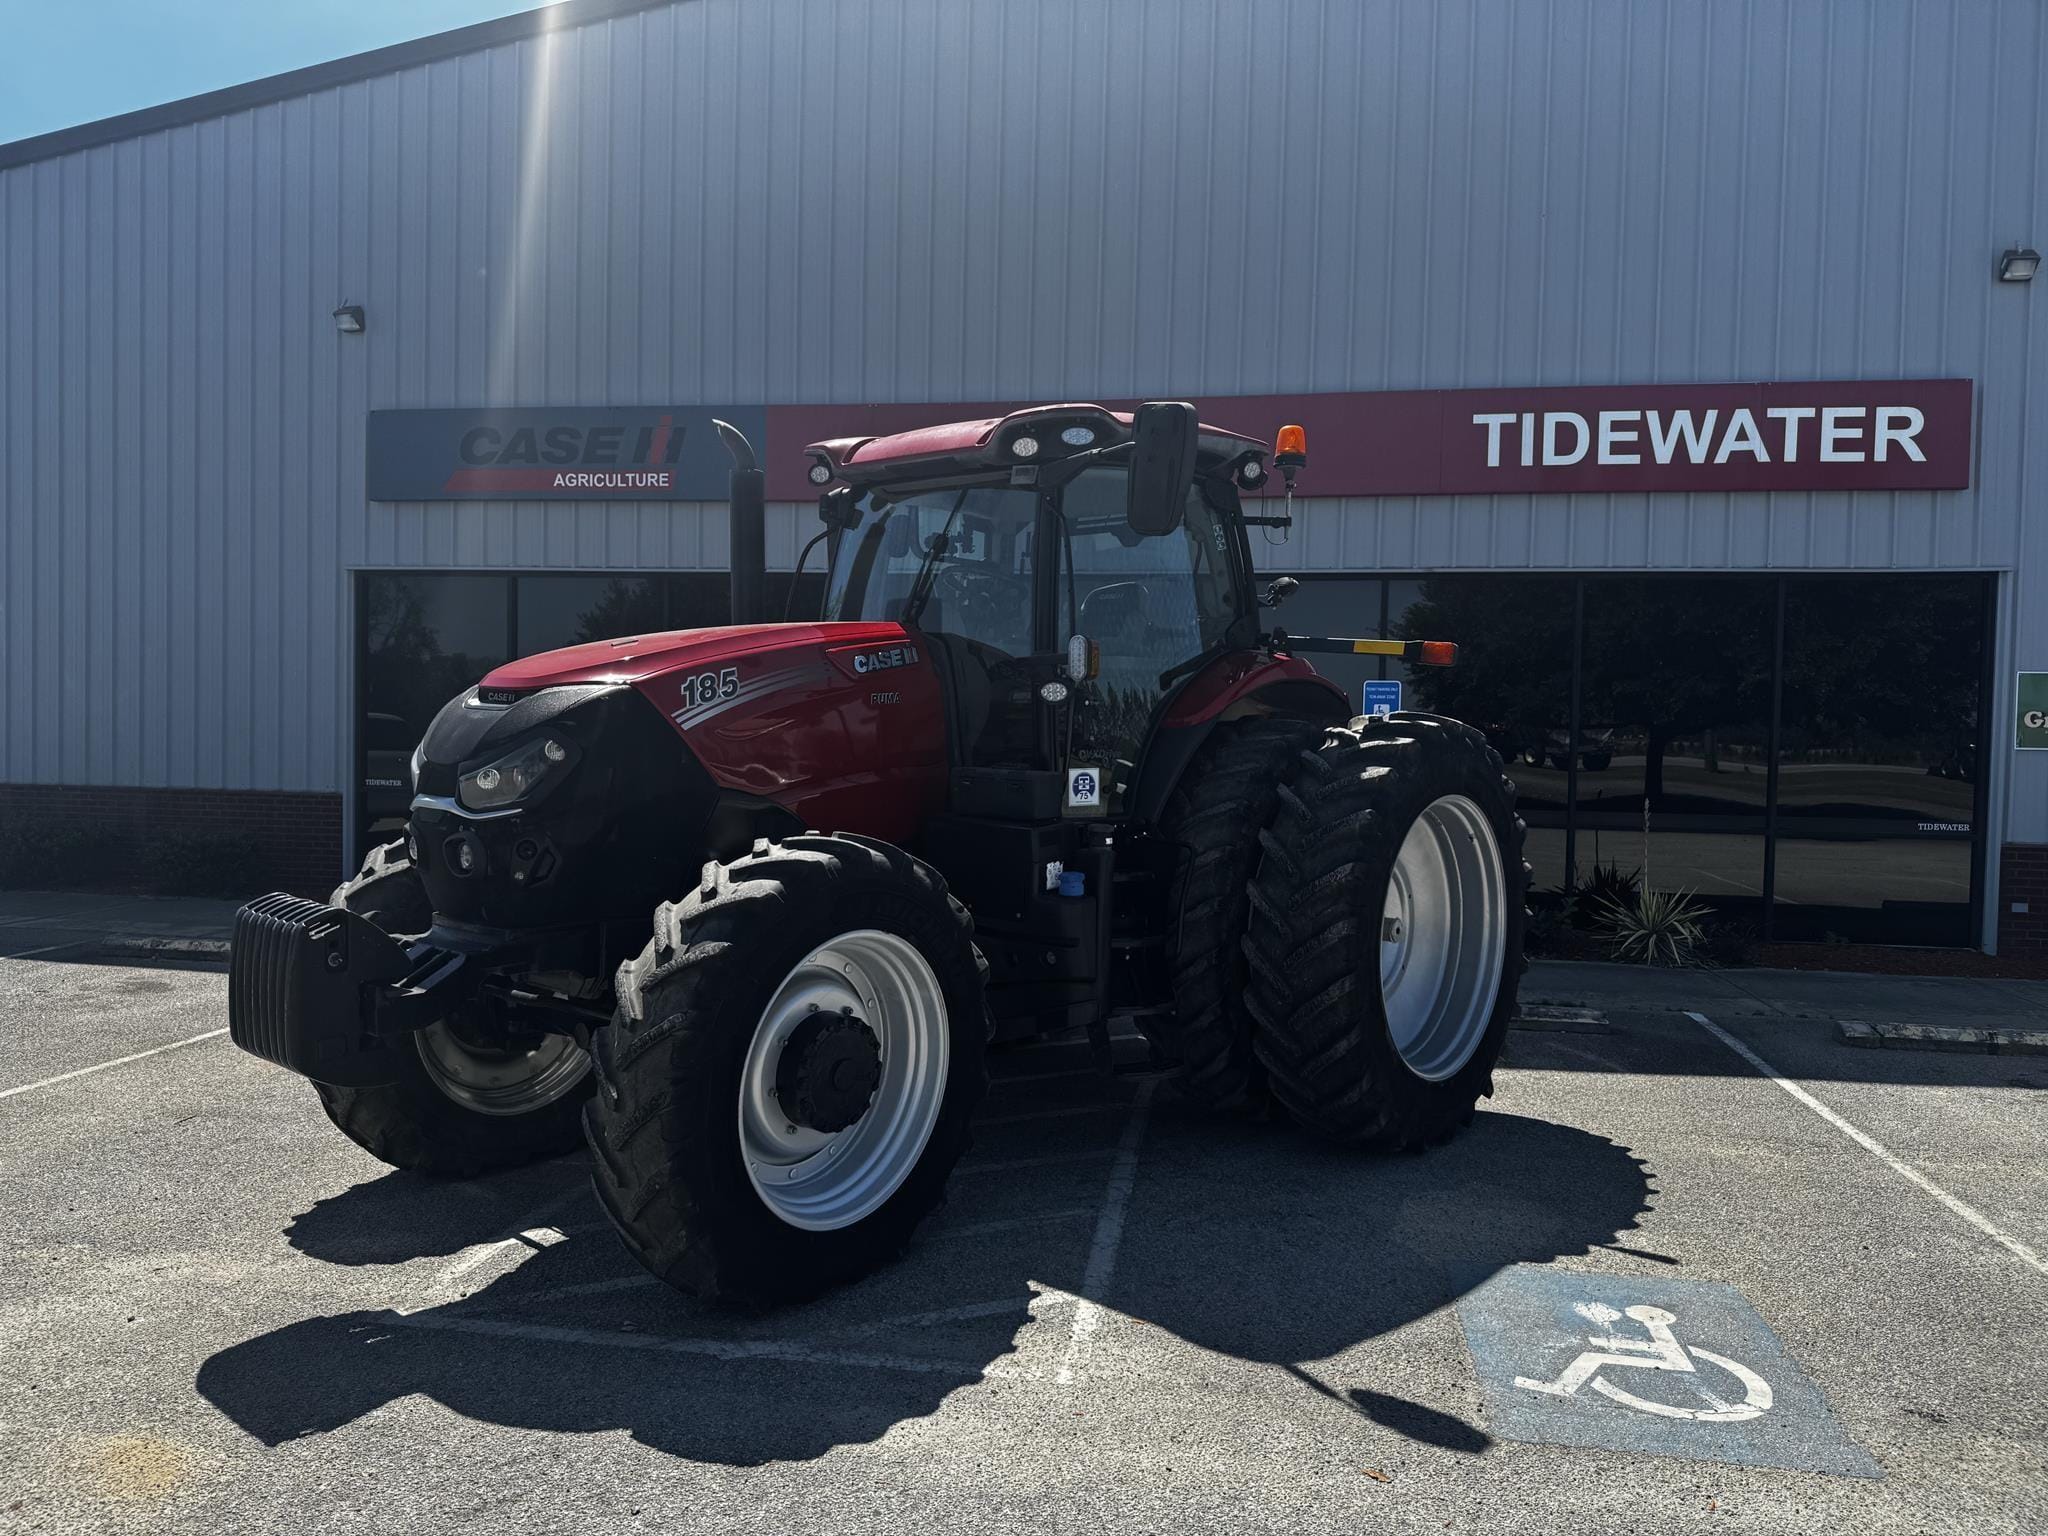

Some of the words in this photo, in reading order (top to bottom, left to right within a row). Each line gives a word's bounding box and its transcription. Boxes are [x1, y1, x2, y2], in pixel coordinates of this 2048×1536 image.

[1472, 406, 1927, 467] TIDEWATER
[459, 426, 626, 466] CASE
[553, 472, 670, 488] AGRICULTURE
[854, 649, 903, 674] CASE
[681, 667, 740, 708] 185
[488, 692, 508, 702] CASE
[870, 692, 904, 705] PUMA
[364, 779, 402, 787] TIDEWATER
[1918, 823, 1970, 832] TIDEWATER
